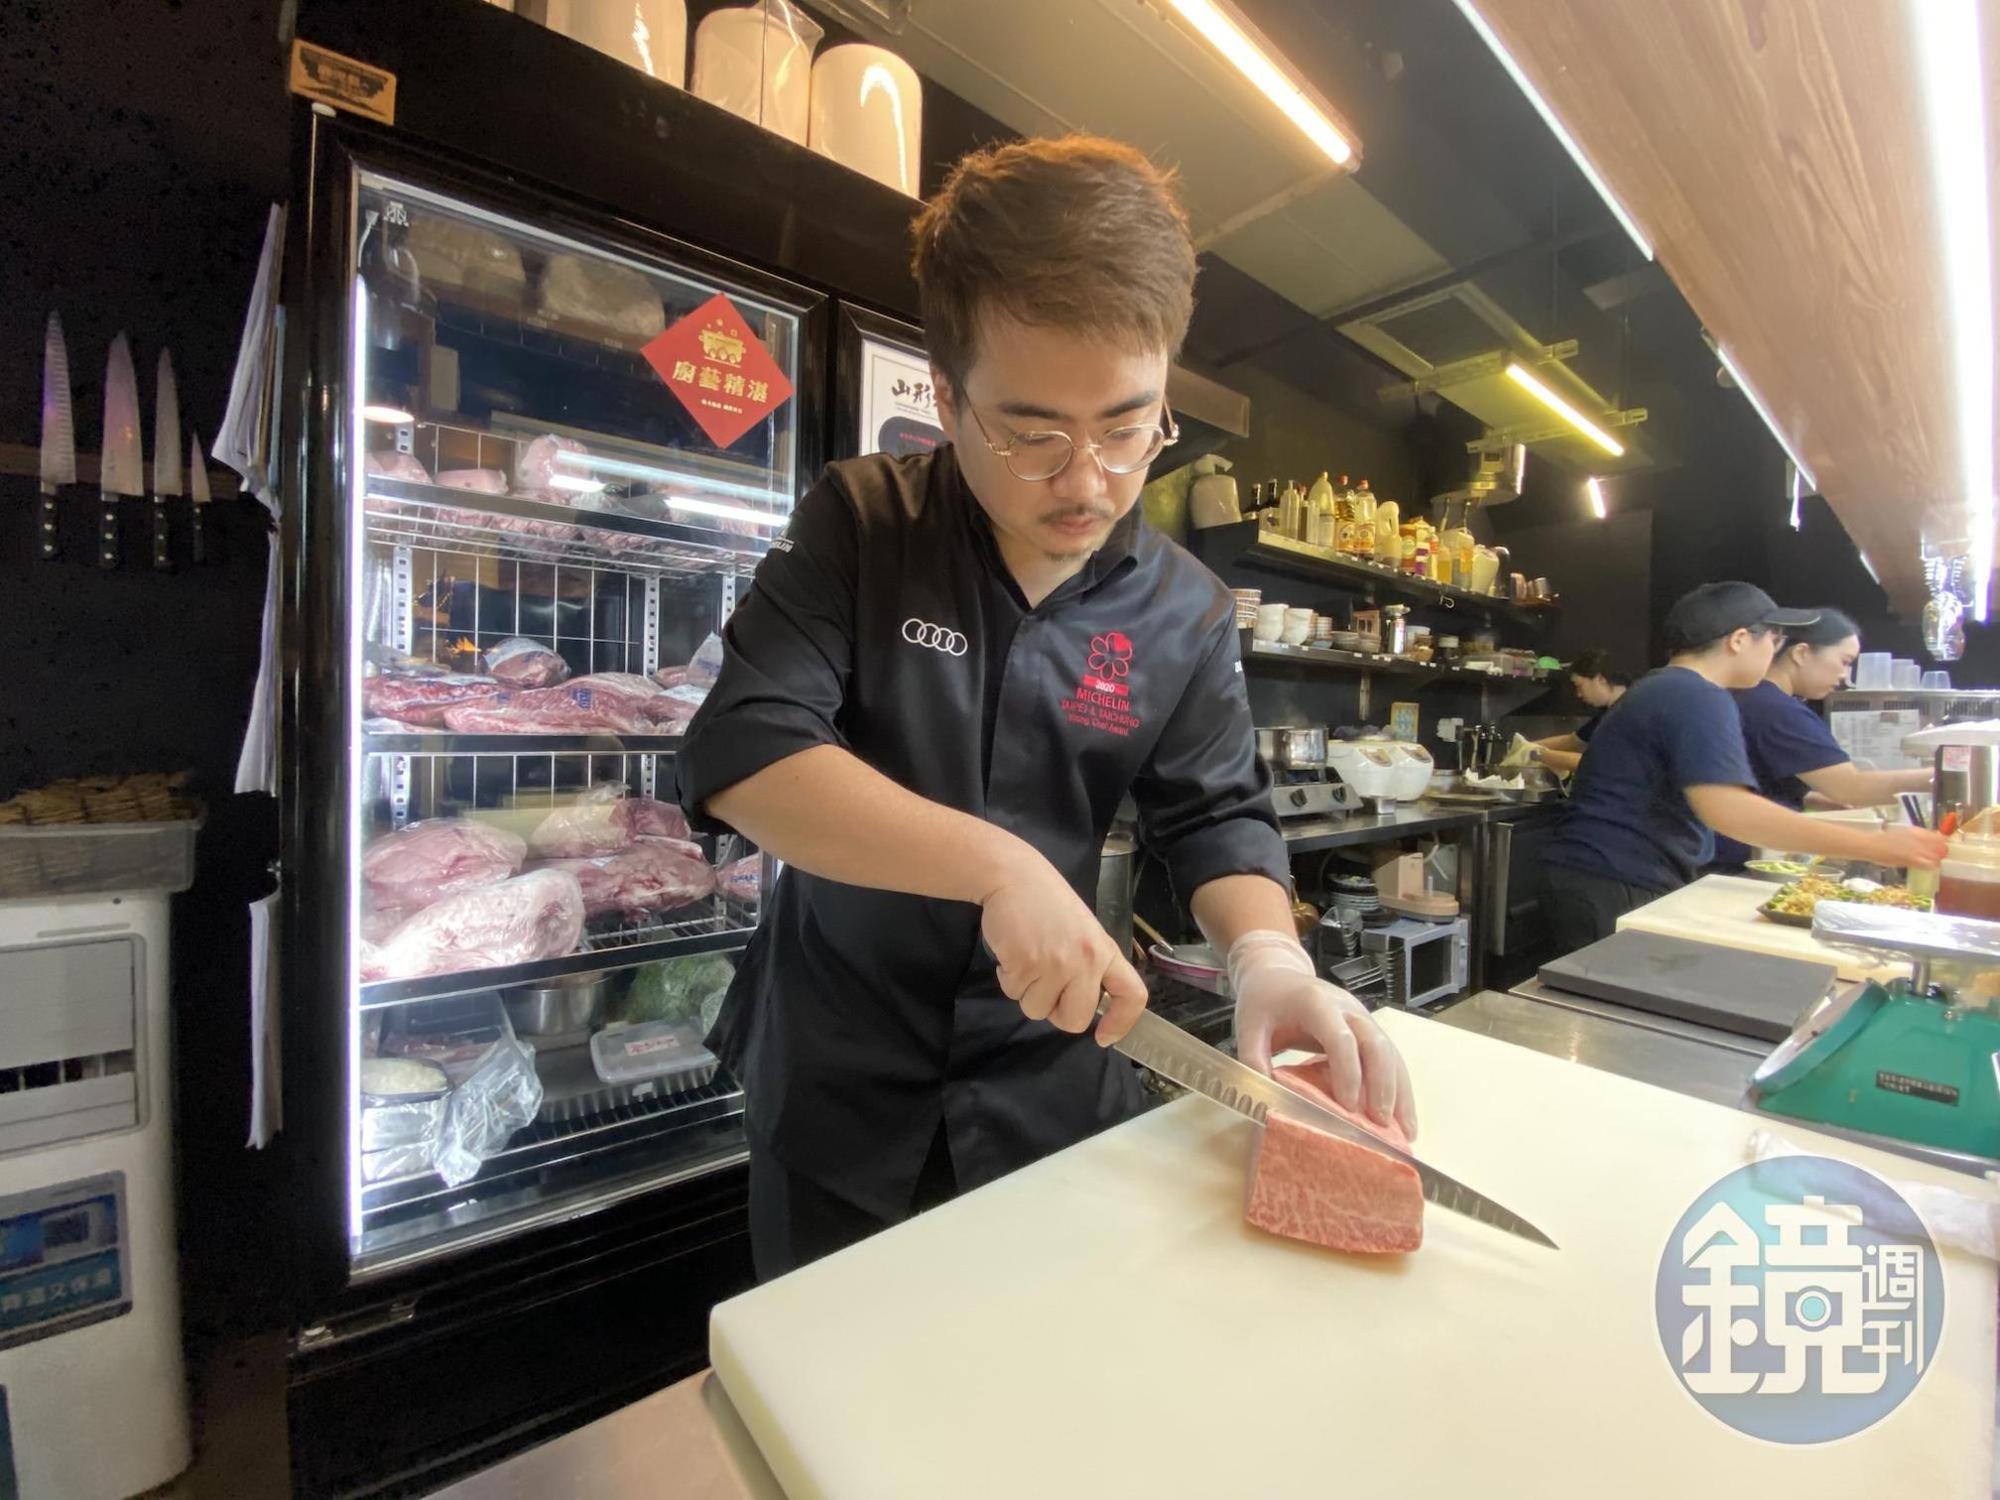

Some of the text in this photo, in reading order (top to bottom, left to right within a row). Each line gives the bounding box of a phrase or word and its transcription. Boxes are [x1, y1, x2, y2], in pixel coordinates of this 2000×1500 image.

[672, 360, 769, 403] 廚藝精湛
[891, 379, 938, 409] 山形
[1076, 687, 1130, 711] MICHELIN
[1095, 679, 1115, 693] 2020
